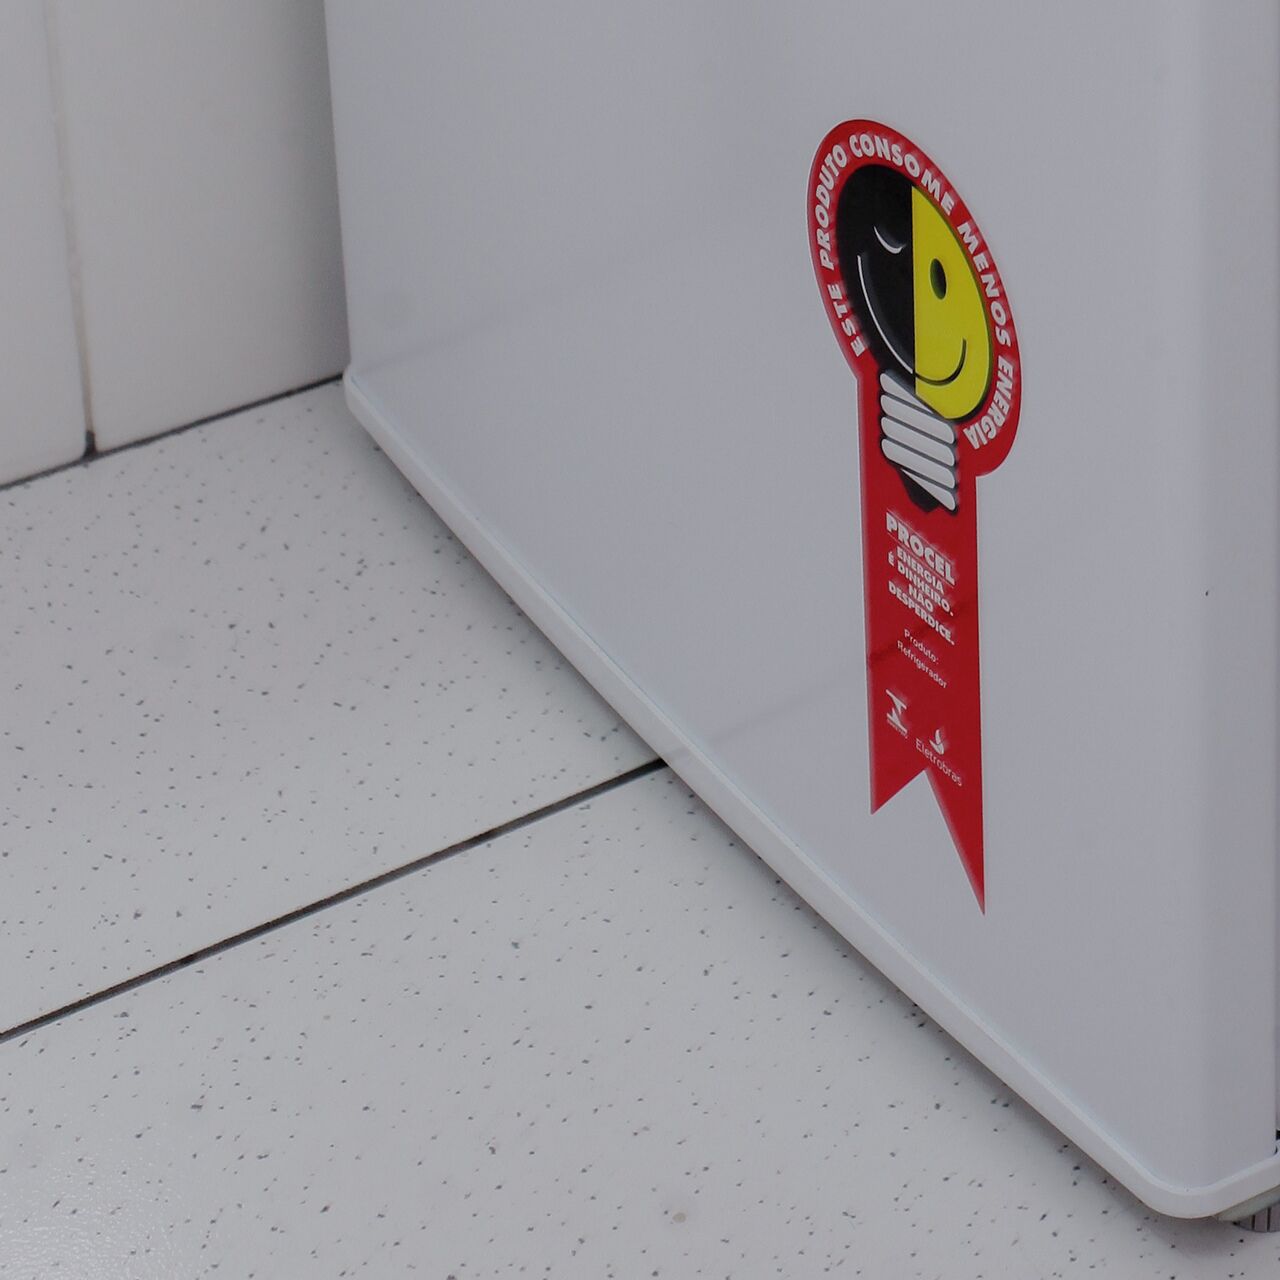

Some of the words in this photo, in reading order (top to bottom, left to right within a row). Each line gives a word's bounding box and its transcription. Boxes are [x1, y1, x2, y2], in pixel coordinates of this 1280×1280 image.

[814, 143, 848, 271] PRODUTO
[849, 133, 954, 215] CONSOME
[957, 222, 1012, 348] MENOS
[827, 282, 866, 358] ESTE
[964, 355, 1014, 450] ENERGIA
[886, 512, 956, 586] PROCEL
[896, 546, 944, 594] ENERGIA
[888, 551, 895, 567] É
[898, 563, 954, 617] DINHEIRO.
[888, 580, 955, 645] DESPERDICE.
[908, 579, 934, 613] NÃO
[897, 639, 948, 689] Refrigerador
[904, 628, 940, 666] Produto:
[915, 737, 963, 787] Eletrobras
